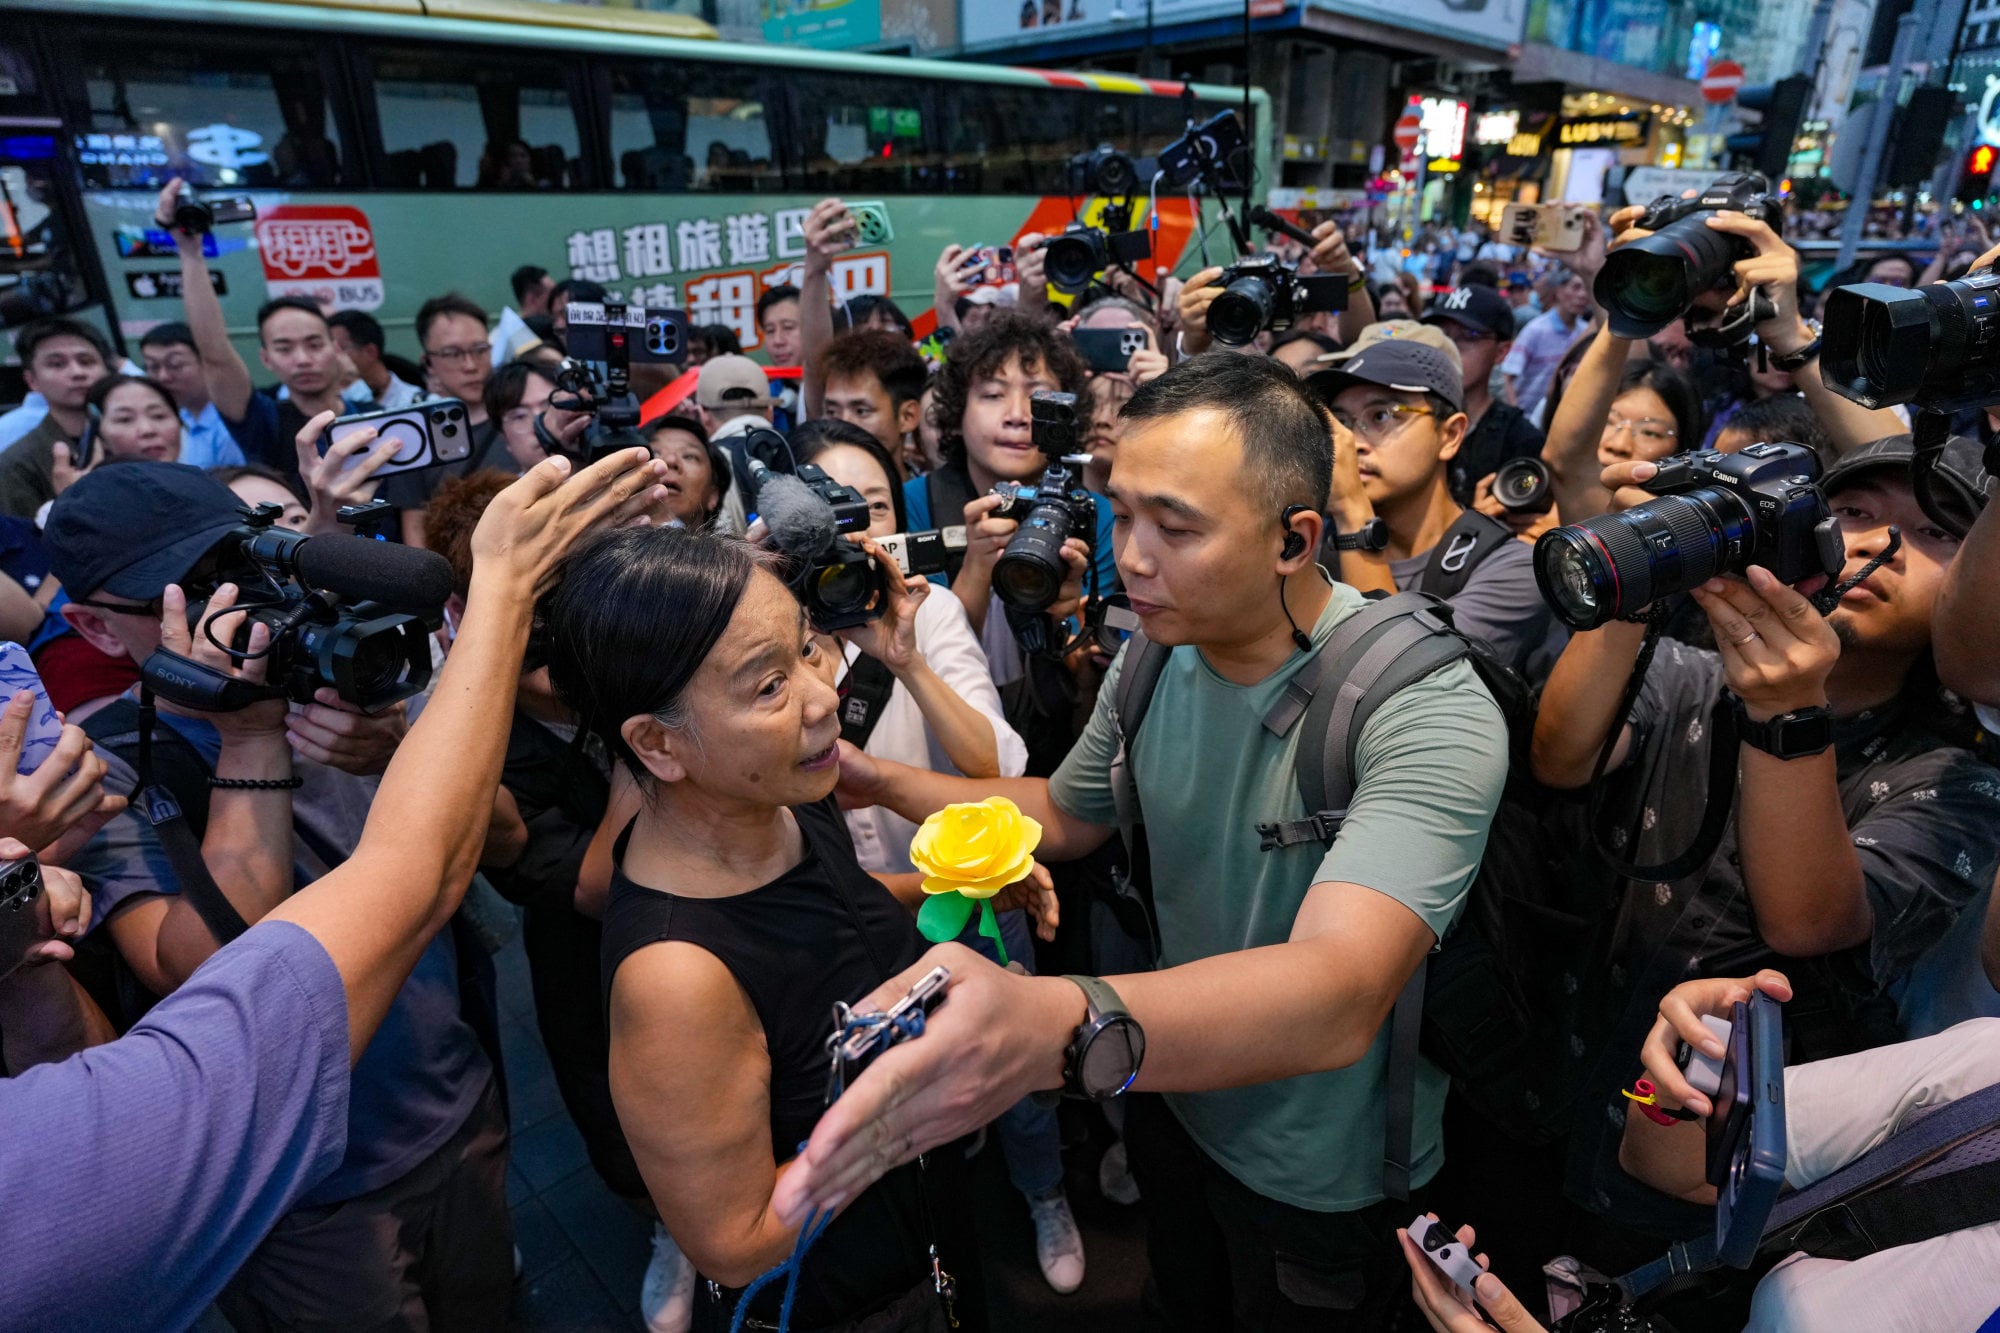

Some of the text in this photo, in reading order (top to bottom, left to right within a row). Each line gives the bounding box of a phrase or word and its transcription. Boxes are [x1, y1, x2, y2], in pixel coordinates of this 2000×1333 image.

[338, 285, 380, 303] BUS
[1712, 470, 1738, 485] Canon
[1759, 500, 1776, 509] EOS
[917, 534, 937, 543] SONY
[156, 667, 197, 689] SONY
